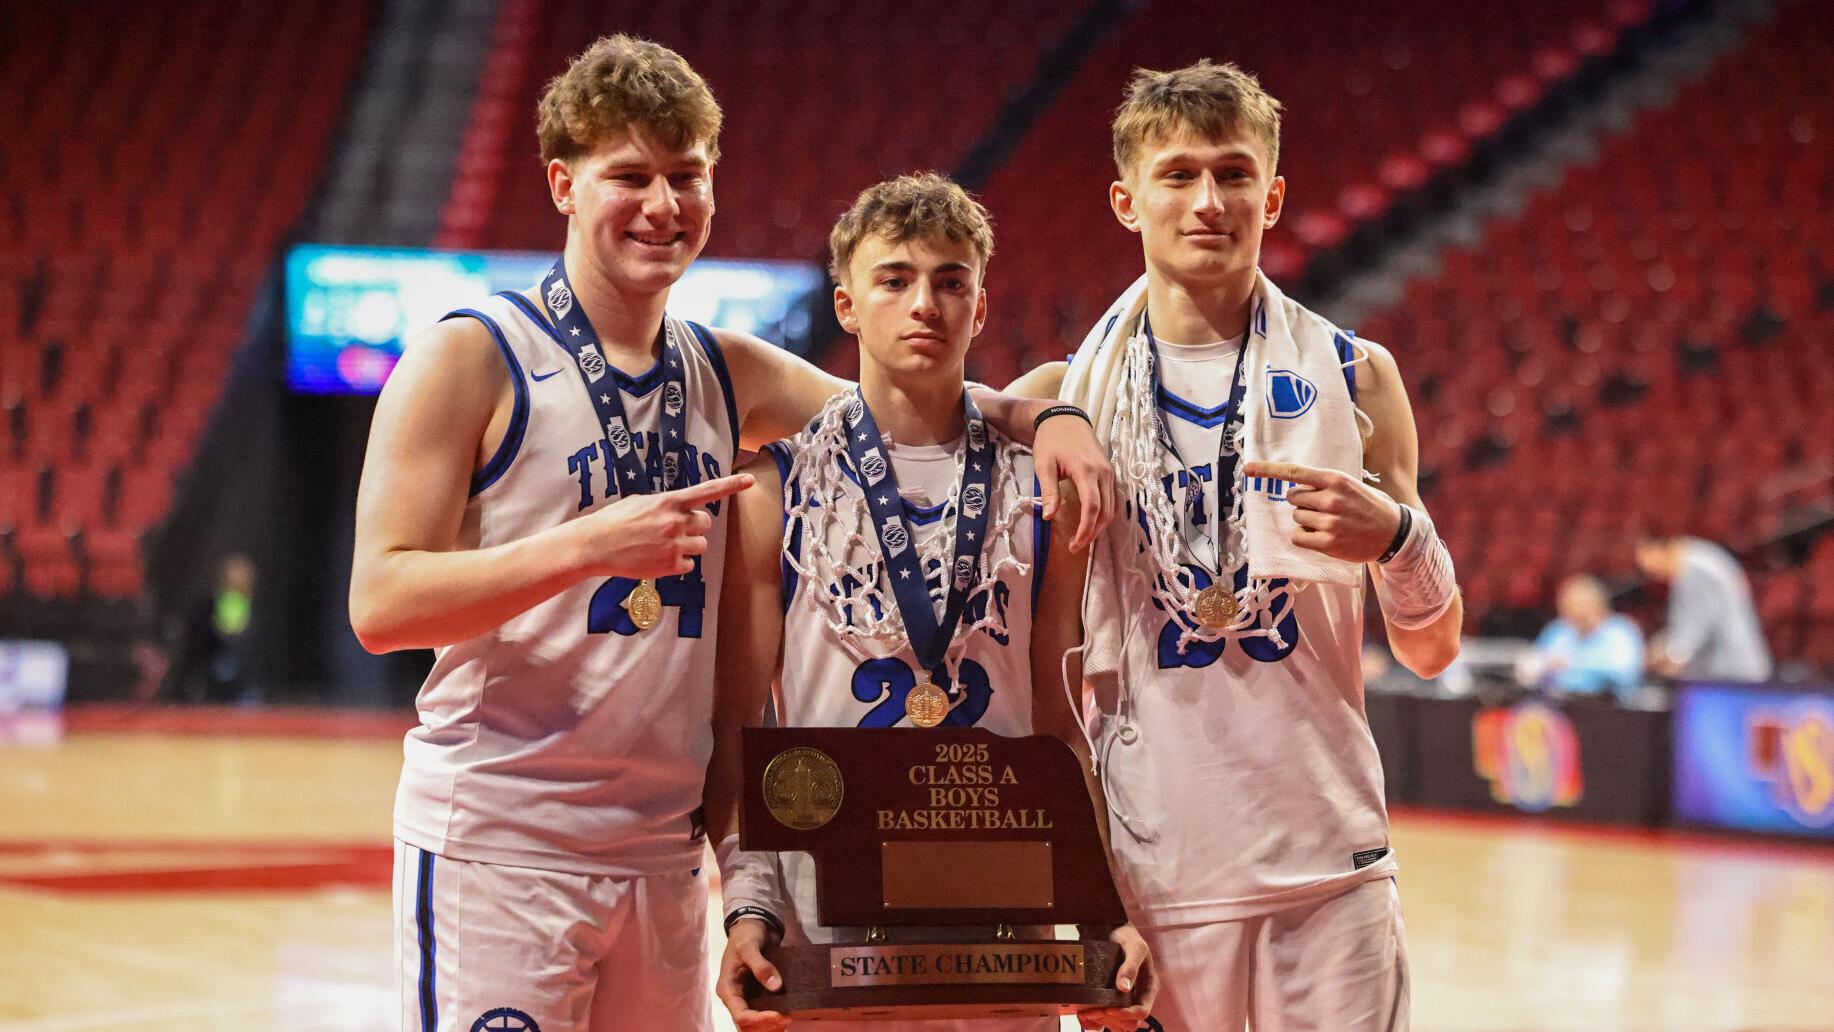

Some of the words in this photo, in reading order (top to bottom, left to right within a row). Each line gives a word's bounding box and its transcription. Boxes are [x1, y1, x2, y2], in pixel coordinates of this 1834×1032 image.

[935, 743, 989, 763] 2025
[908, 765, 993, 785] CLASS
[1000, 765, 1019, 785] A
[929, 787, 999, 807] BOYS
[877, 809, 1053, 830] BASKETBALL
[840, 954, 928, 977] STATE
[935, 953, 1078, 975] CHAMPION
